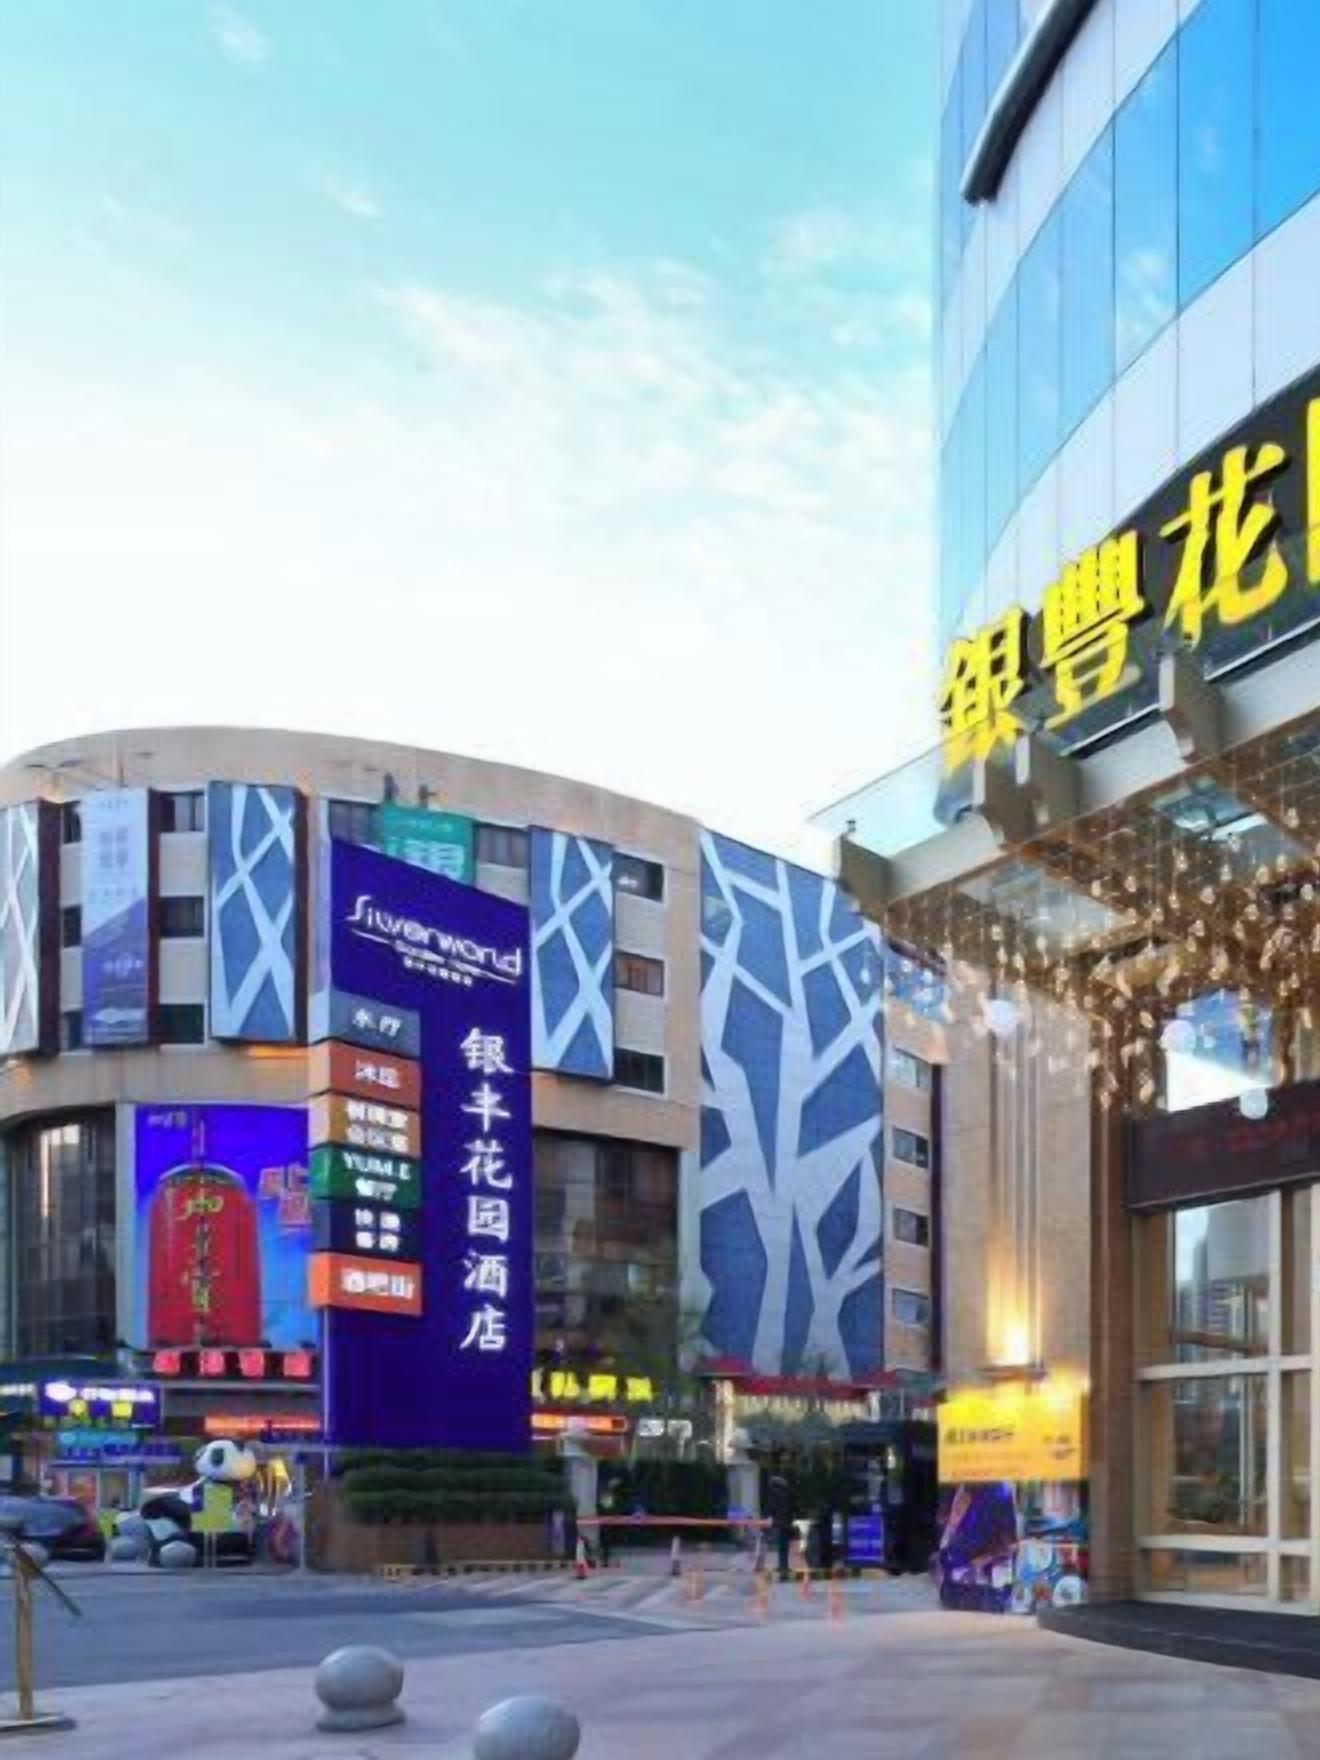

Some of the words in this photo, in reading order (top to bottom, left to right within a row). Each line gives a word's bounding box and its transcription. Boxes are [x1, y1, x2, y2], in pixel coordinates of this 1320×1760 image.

[458, 1026, 515, 1352] 银丰花园酒店
